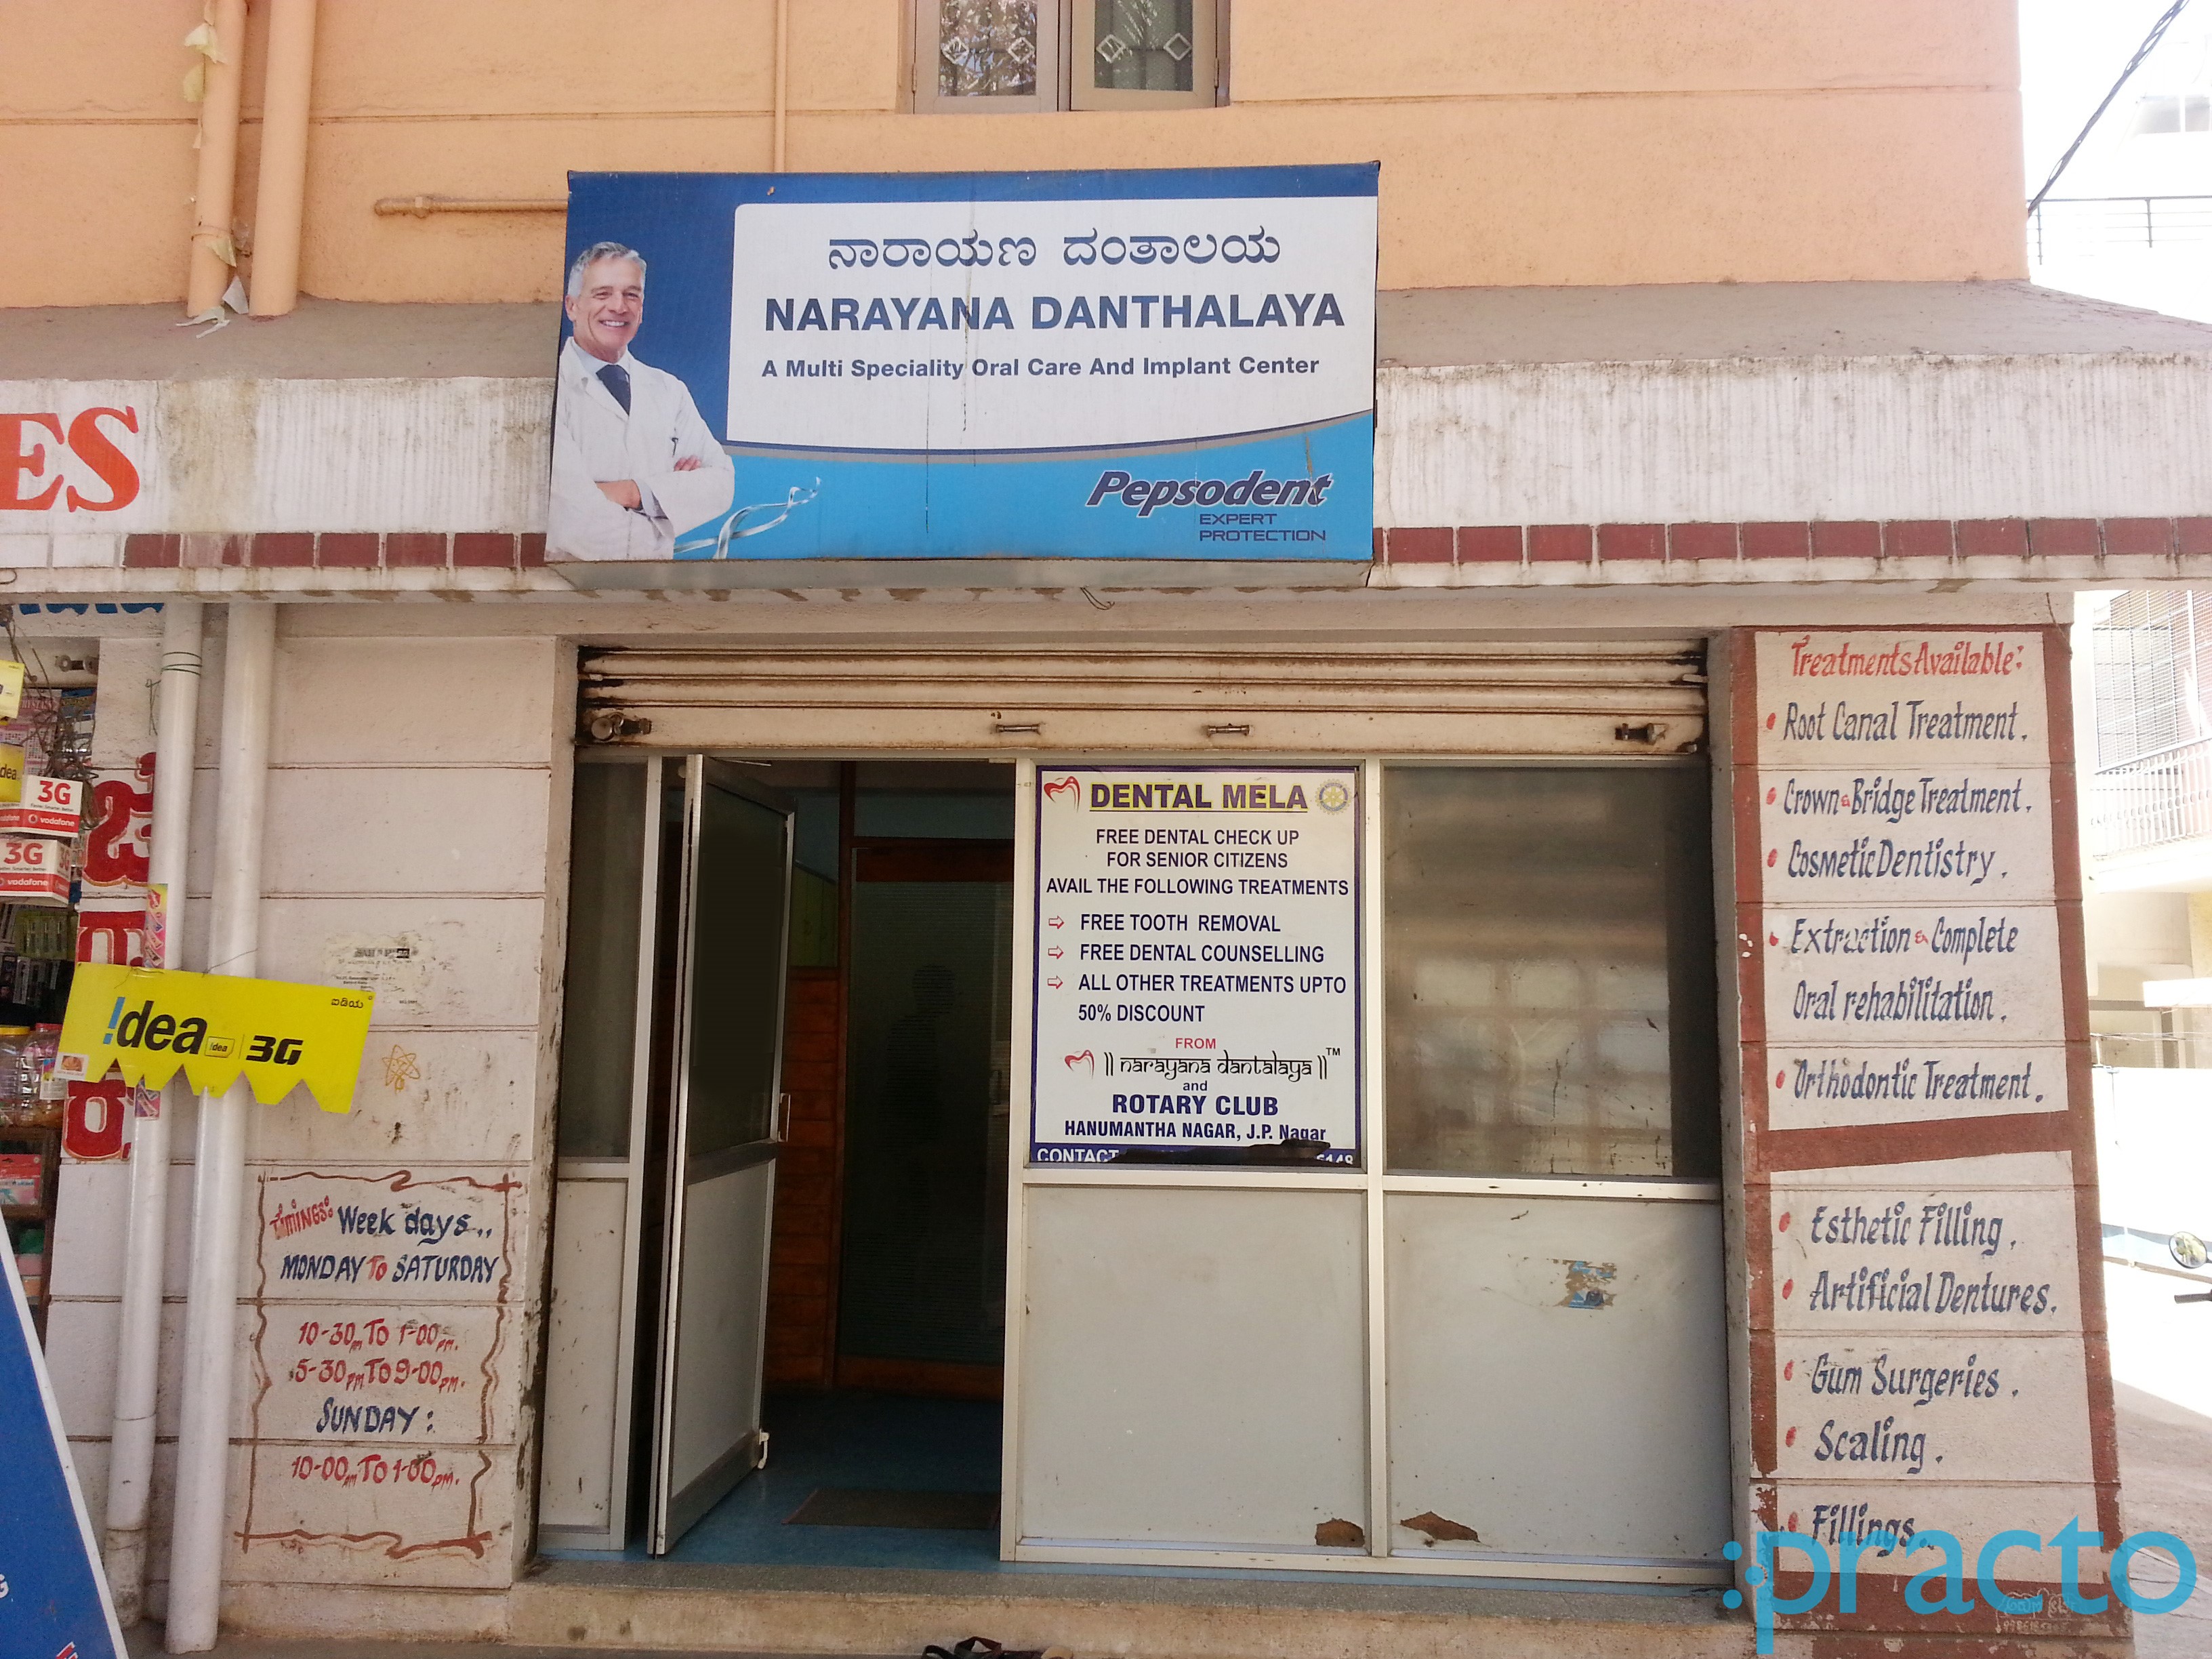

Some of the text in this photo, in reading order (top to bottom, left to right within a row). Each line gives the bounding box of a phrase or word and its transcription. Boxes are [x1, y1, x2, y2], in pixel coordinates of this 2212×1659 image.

[828, 224, 1282, 270] ನಾರಾಯಣ ದಂತಾಲಯ
[764, 293, 1345, 331] NARAYANA DANTHALAYA
[762, 355, 1321, 381] A Multi Speciality Oral Care And Implant Center
[1086, 470, 1334, 518] Pepsodent
[1199, 513, 1278, 526] EXPERT
[1199, 529, 1328, 542] PROTECTION
[1791, 634, 2024, 678] Treatments Available:
[1784, 699, 2028, 742] Root Canal Treatment.
[37, 780, 71, 805] 3G
[1090, 783, 1212, 809] DENTAL
[1223, 783, 1307, 809] MELA
[1784, 777, 1839, 816] Crown
[1851, 776, 1916, 823] Bridge
[1919, 777, 2033, 815] Treatment.
[41, 817, 75, 827] vodafone
[1097, 828, 1300, 846] FREE DENTAL CHECK UP
[3, 842, 43, 865] 3G
[1107, 852, 1289, 869] FOR SENIOR CITIZENS
[1788, 836, 1876, 879] Cosmetic
[1046, 878, 1349, 896] AVAIL THE FOLLOWING TREATMENTS
[1080, 914, 1282, 933] FREE TOOTH REMOVAL
[1080, 943, 1325, 963] FREE DENTAL COUNSELLING
[1791, 915, 1911, 955] Extraction
[1931, 916, 2018, 966] Complete
[1078, 974, 1347, 994] ALL OTHER TREATMENTS UPTO
[1078, 1004, 1206, 1023] 50% DISCOUNT
[1793, 980, 1838, 1021] Oral
[246, 1035, 304, 1065] 3G
[1175, 1038, 1216, 1049] FROM
[1120, 1057, 1211, 1080] narayana
[1217, 1050, 1313, 1082] dantalaya
[1183, 1080, 1208, 1092] and
[1794, 1056, 2045, 1104] Orthodontic Treatment.
[1112, 1093, 1279, 1116] ROTARY CLUB
[1065, 1120, 1326, 1142] HANUMANTHA NAGAR, J.P. Nagar
[1037, 1148, 1120, 1162] CONTACT
[337, 1206, 396, 1236] Week
[1810, 1200, 1910, 1248] Esthetic
[280, 1254, 367, 1282] MONDAY
[392, 1253, 500, 1284] SATURDAY
[1809, 1266, 2057, 1316] Artificial Dentures.
[1810, 1351, 1862, 1396] Gum
